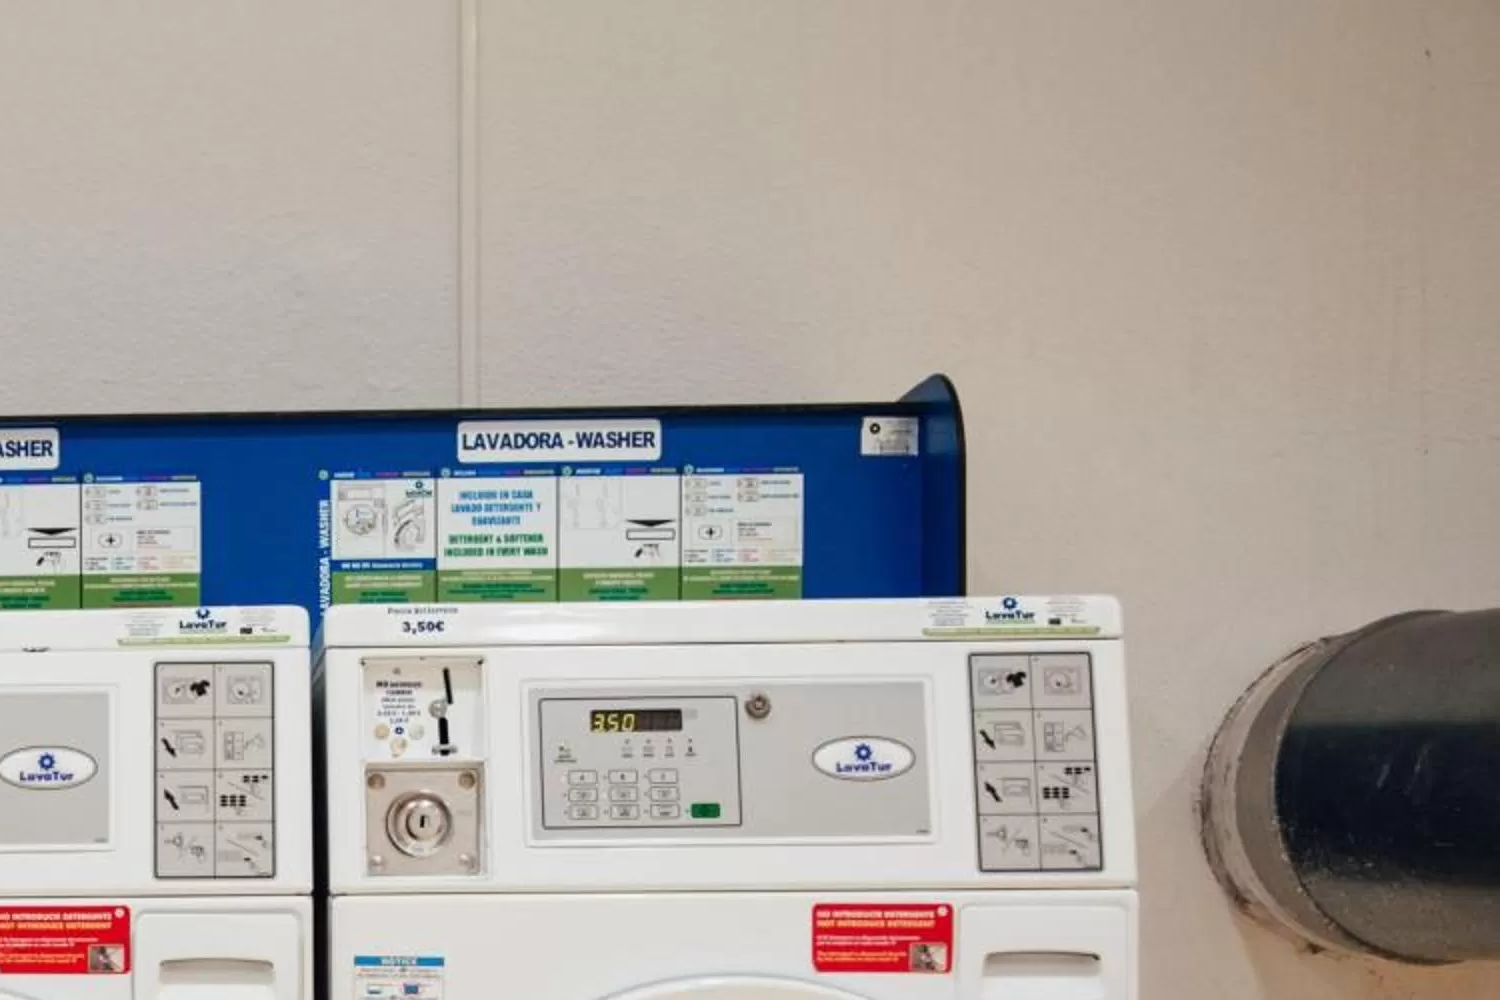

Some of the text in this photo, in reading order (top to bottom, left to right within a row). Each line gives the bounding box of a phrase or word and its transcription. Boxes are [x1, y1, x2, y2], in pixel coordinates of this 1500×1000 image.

[461, 431, 564, 451] LAVADORA
[577, 430, 656, 449] WASHER
[402, 620, 445, 635] 3,50€
